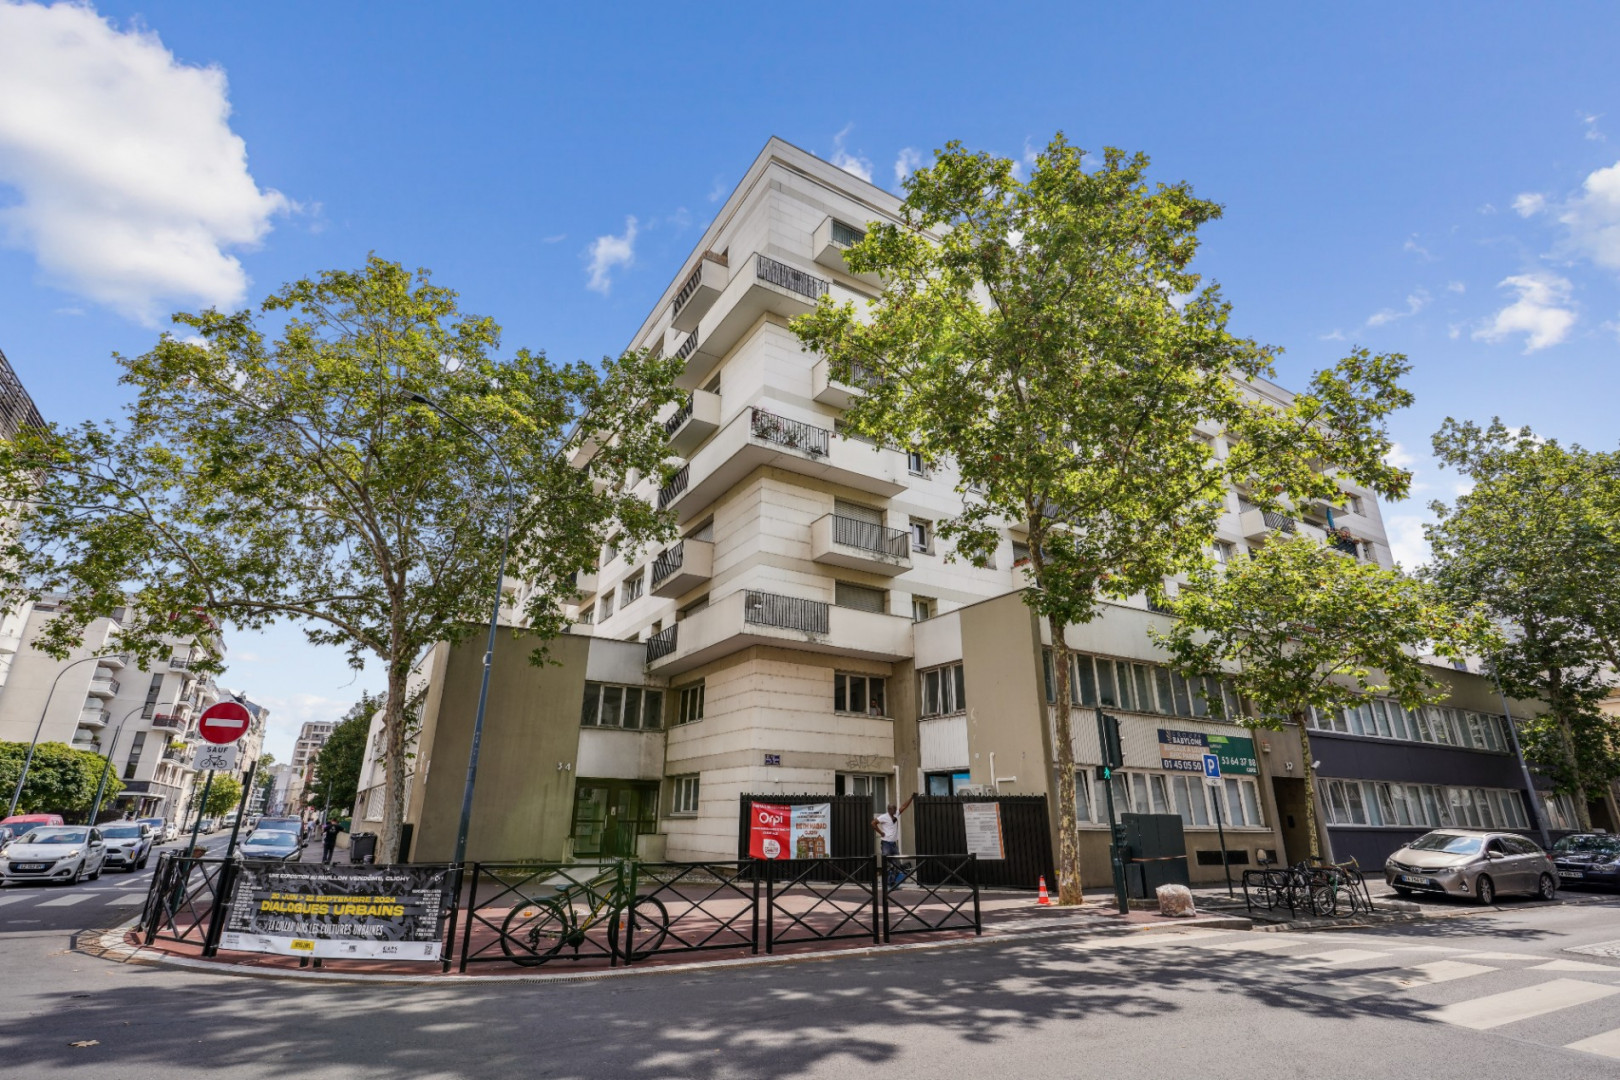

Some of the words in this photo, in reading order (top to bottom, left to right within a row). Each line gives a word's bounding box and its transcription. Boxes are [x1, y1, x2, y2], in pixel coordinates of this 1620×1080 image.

[558, 761, 570, 770] 34
[1164, 759, 1172, 768] 01
[1174, 760, 1182, 769] 45
[1183, 761, 1192, 770] 05
[1193, 762, 1202, 770] 50
[1207, 758, 1214, 774] P
[1222, 756, 1230, 764] 53
[1230, 758, 1239, 766] 64
[758, 812, 784, 826] Orpi
[316, 894, 372, 903] SEPTEMBRE
[261, 900, 328, 914] DIALOGUES
[333, 904, 404, 916] URBAINS
[309, 923, 320, 934] LES
[320, 923, 352, 934] CULTURES
[352, 924, 384, 936] URBAINES
